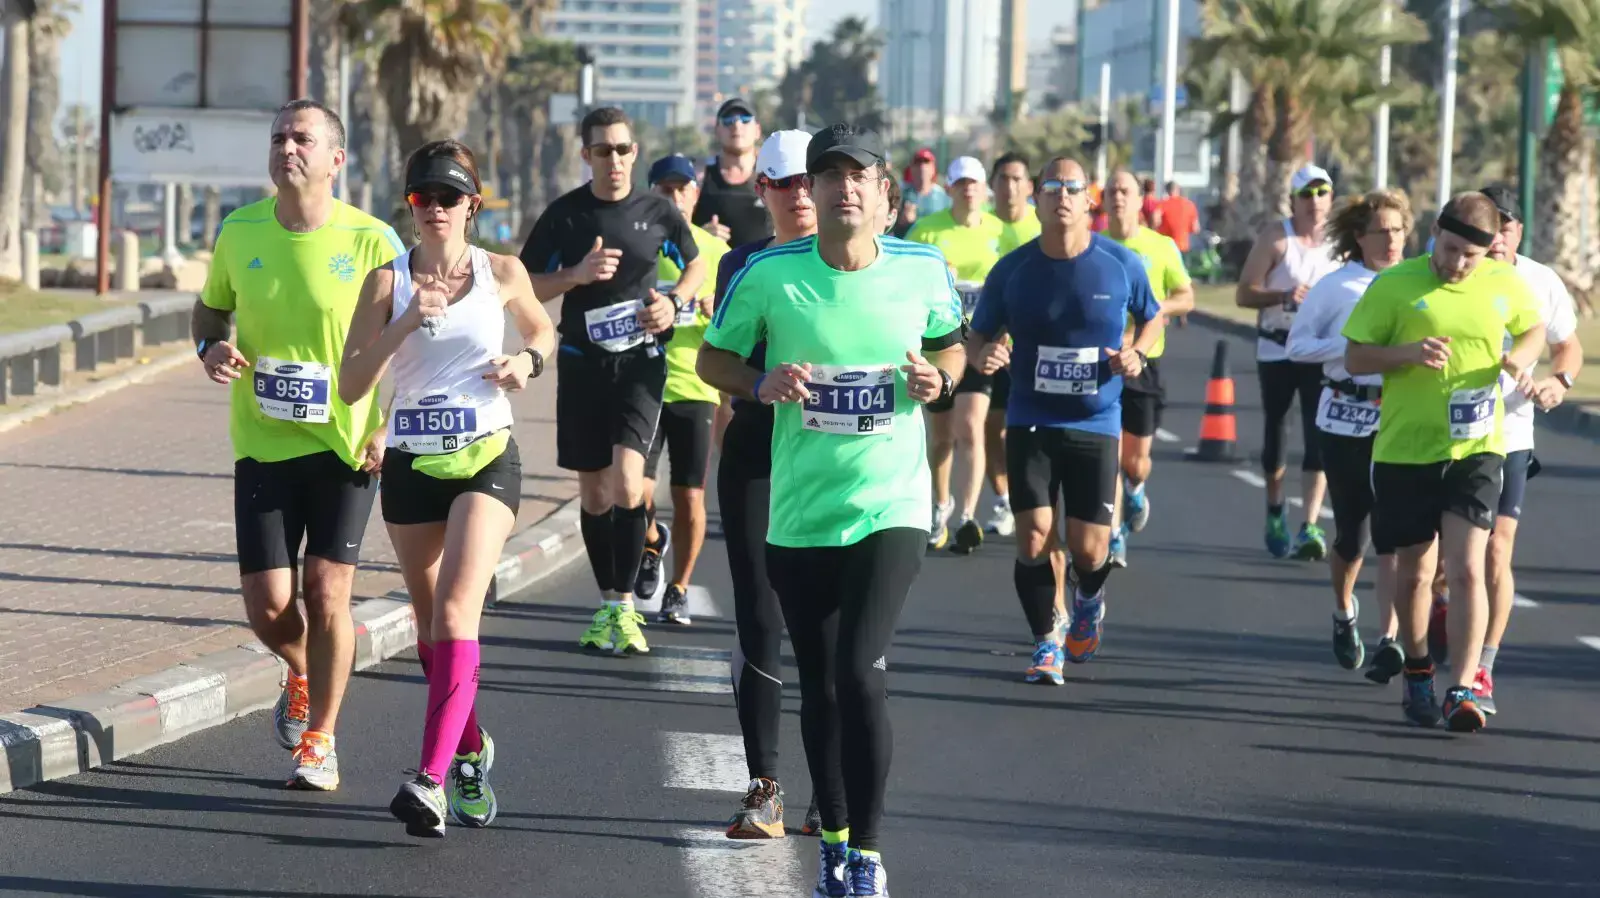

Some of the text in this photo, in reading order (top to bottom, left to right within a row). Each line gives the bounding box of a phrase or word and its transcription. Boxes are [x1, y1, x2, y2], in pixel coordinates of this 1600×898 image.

[449, 169, 468, 181] 2XU
[592, 328, 602, 339] B
[1041, 363, 1092, 379] B 1563
[257, 379, 314, 400] B 955
[809, 388, 886, 410] B 1104
[400, 410, 465, 431] B 1501
[1454, 409, 1463, 420] B
